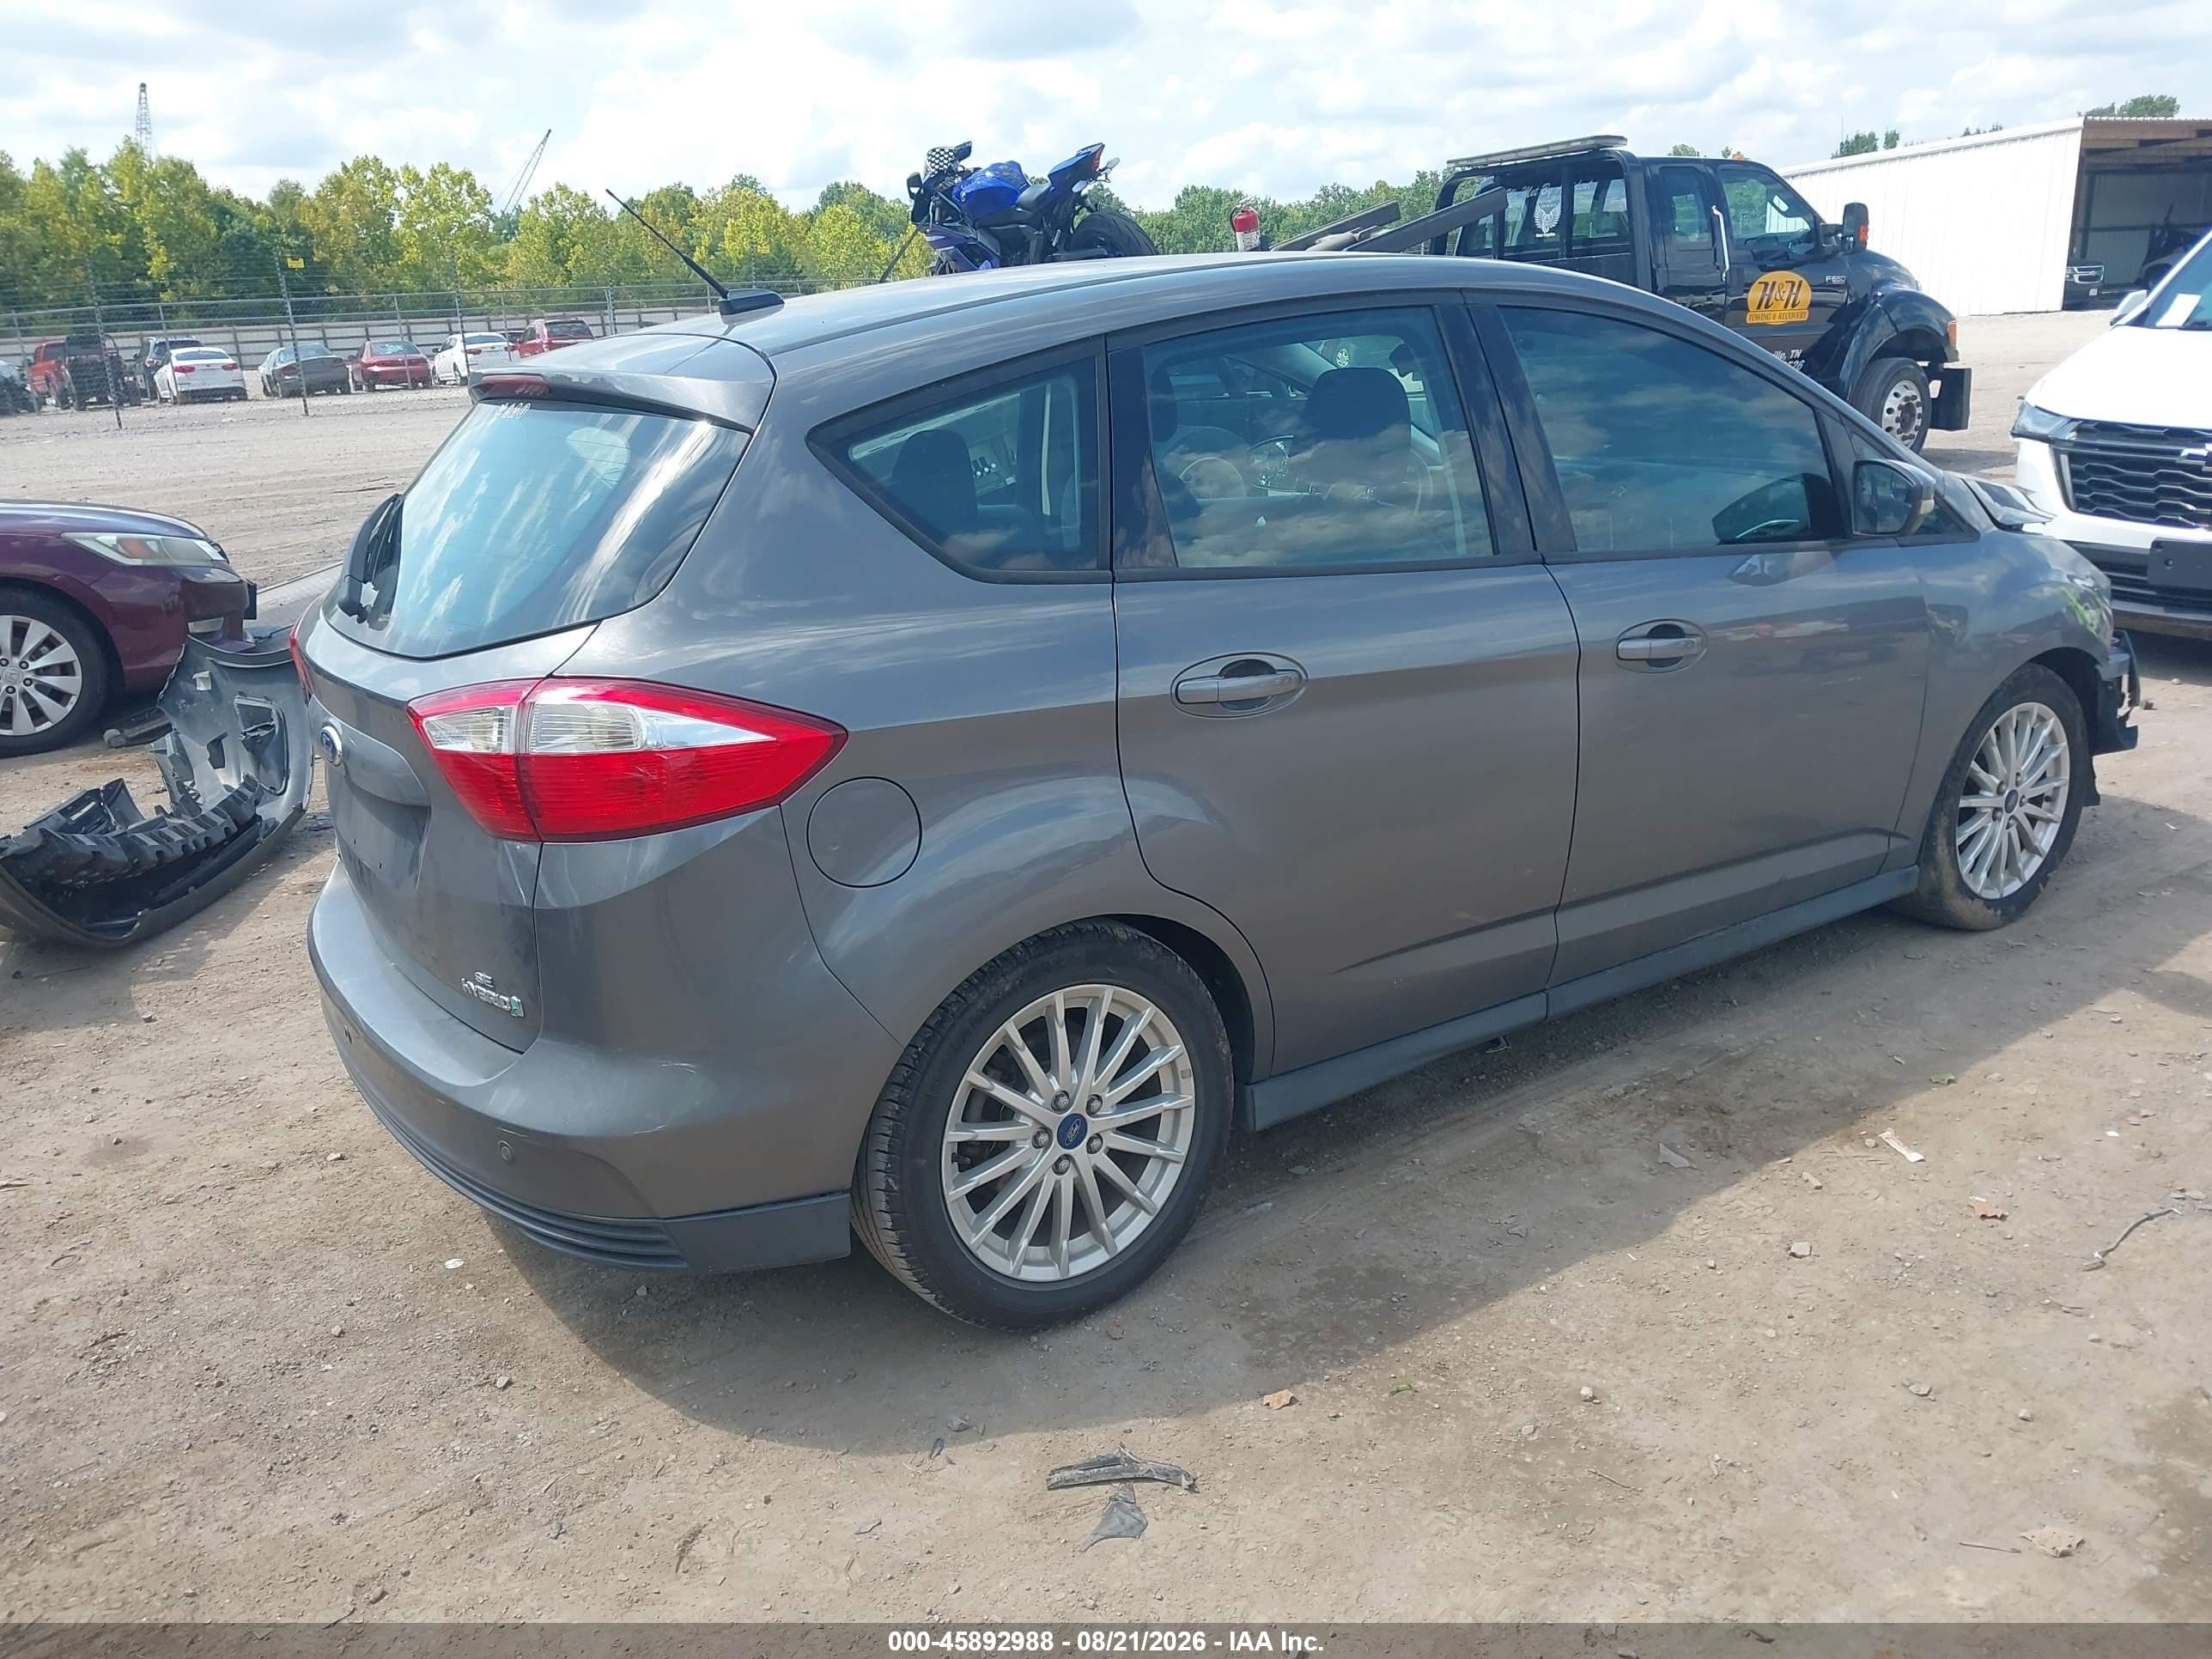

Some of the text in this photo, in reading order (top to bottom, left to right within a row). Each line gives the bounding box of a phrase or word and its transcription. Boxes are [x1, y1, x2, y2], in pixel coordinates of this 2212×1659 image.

[1748, 312, 1771, 322] TOWING
[1778, 310, 1807, 321] RECOVERY
[1790, 349, 1802, 359] TN
[474, 971, 494, 988] SE
